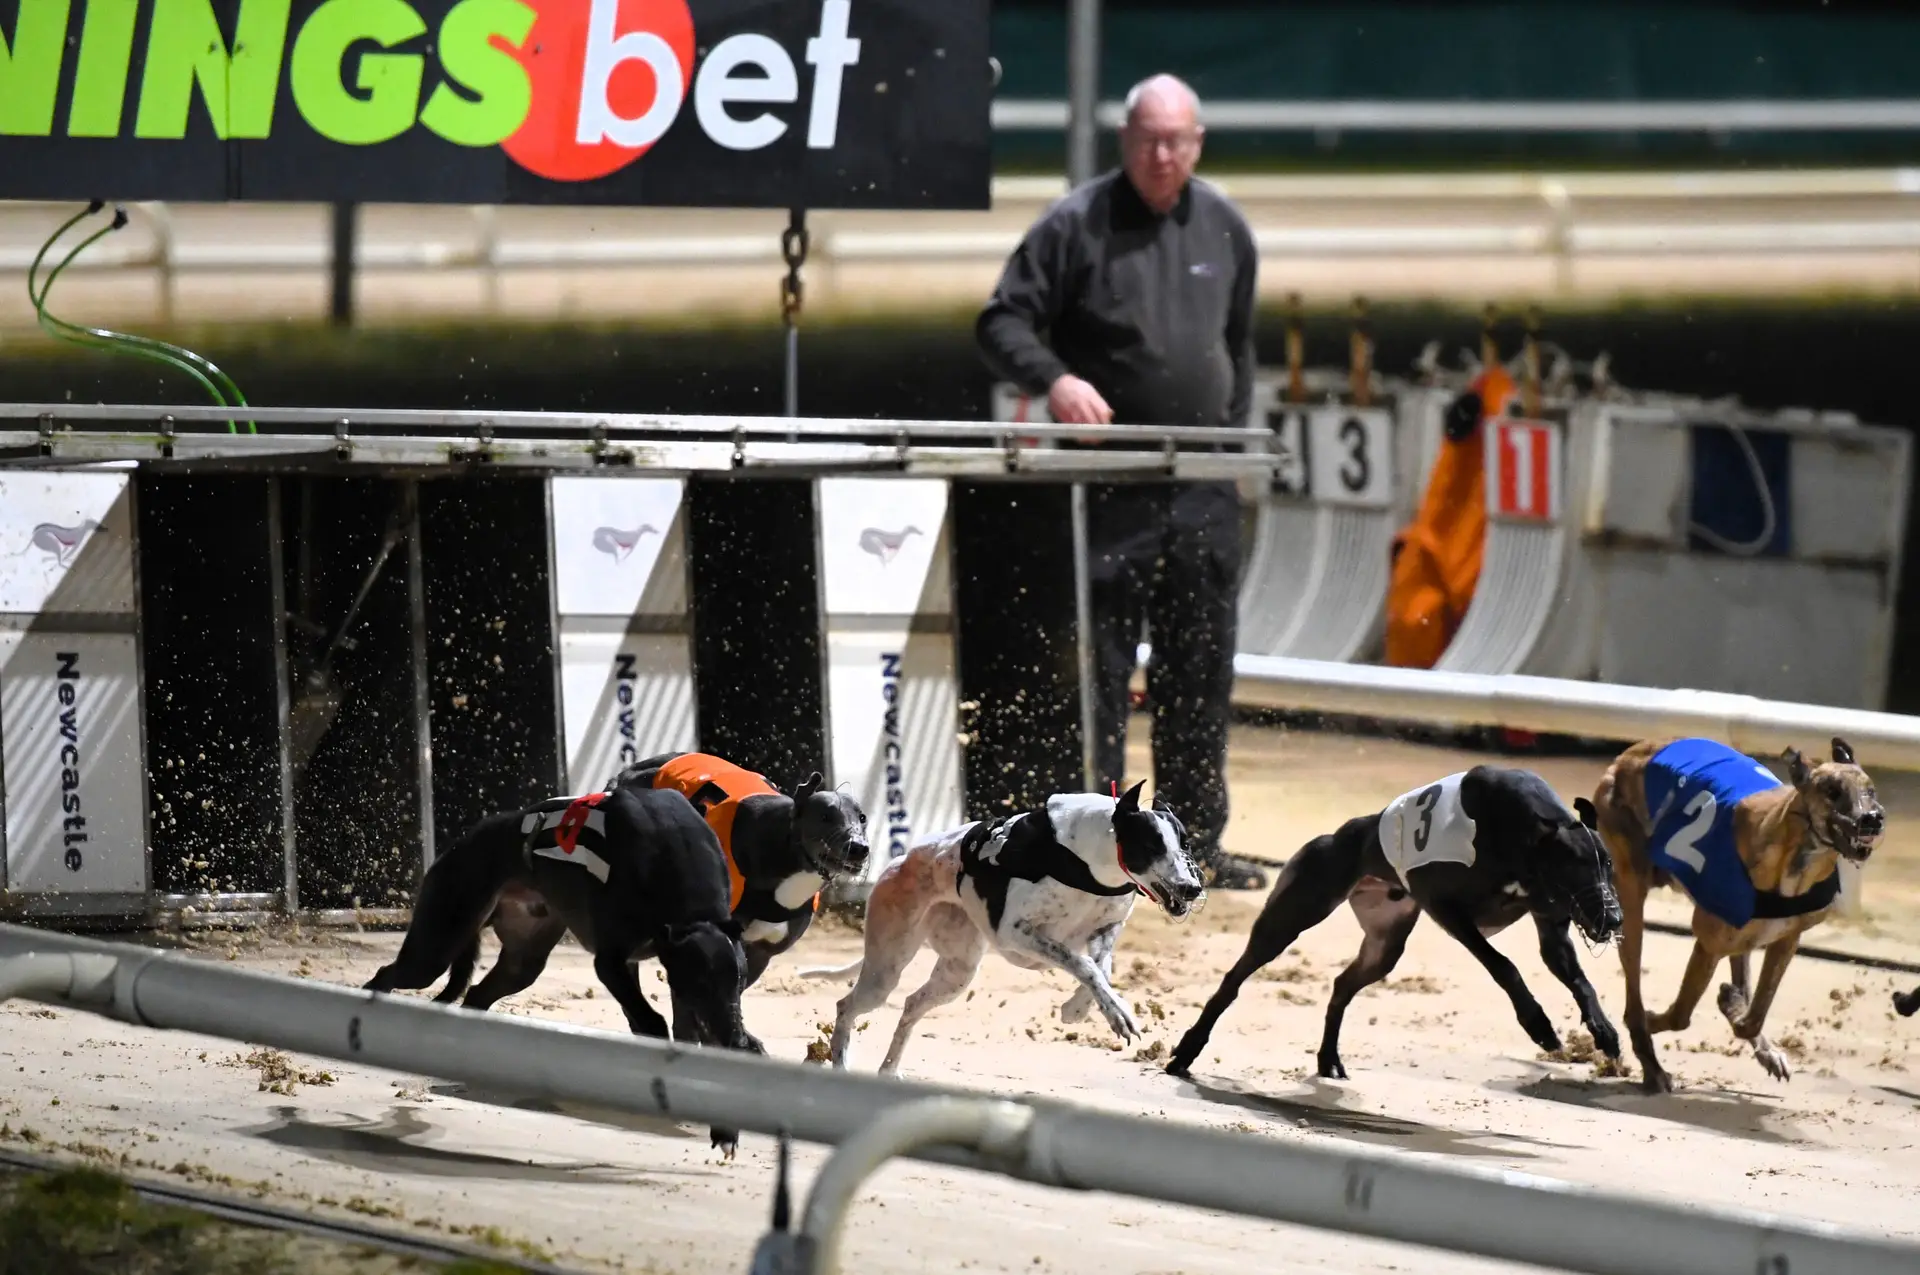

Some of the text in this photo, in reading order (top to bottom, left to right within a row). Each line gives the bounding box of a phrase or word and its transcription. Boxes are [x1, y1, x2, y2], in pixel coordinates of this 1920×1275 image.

[1340, 418, 1369, 492] 3
[1507, 429, 1533, 511] 1
[55, 651, 89, 873] Newcastle
[880, 653, 910, 859] Newcastle
[1414, 784, 1443, 852] 3
[1664, 789, 1717, 874] 2
